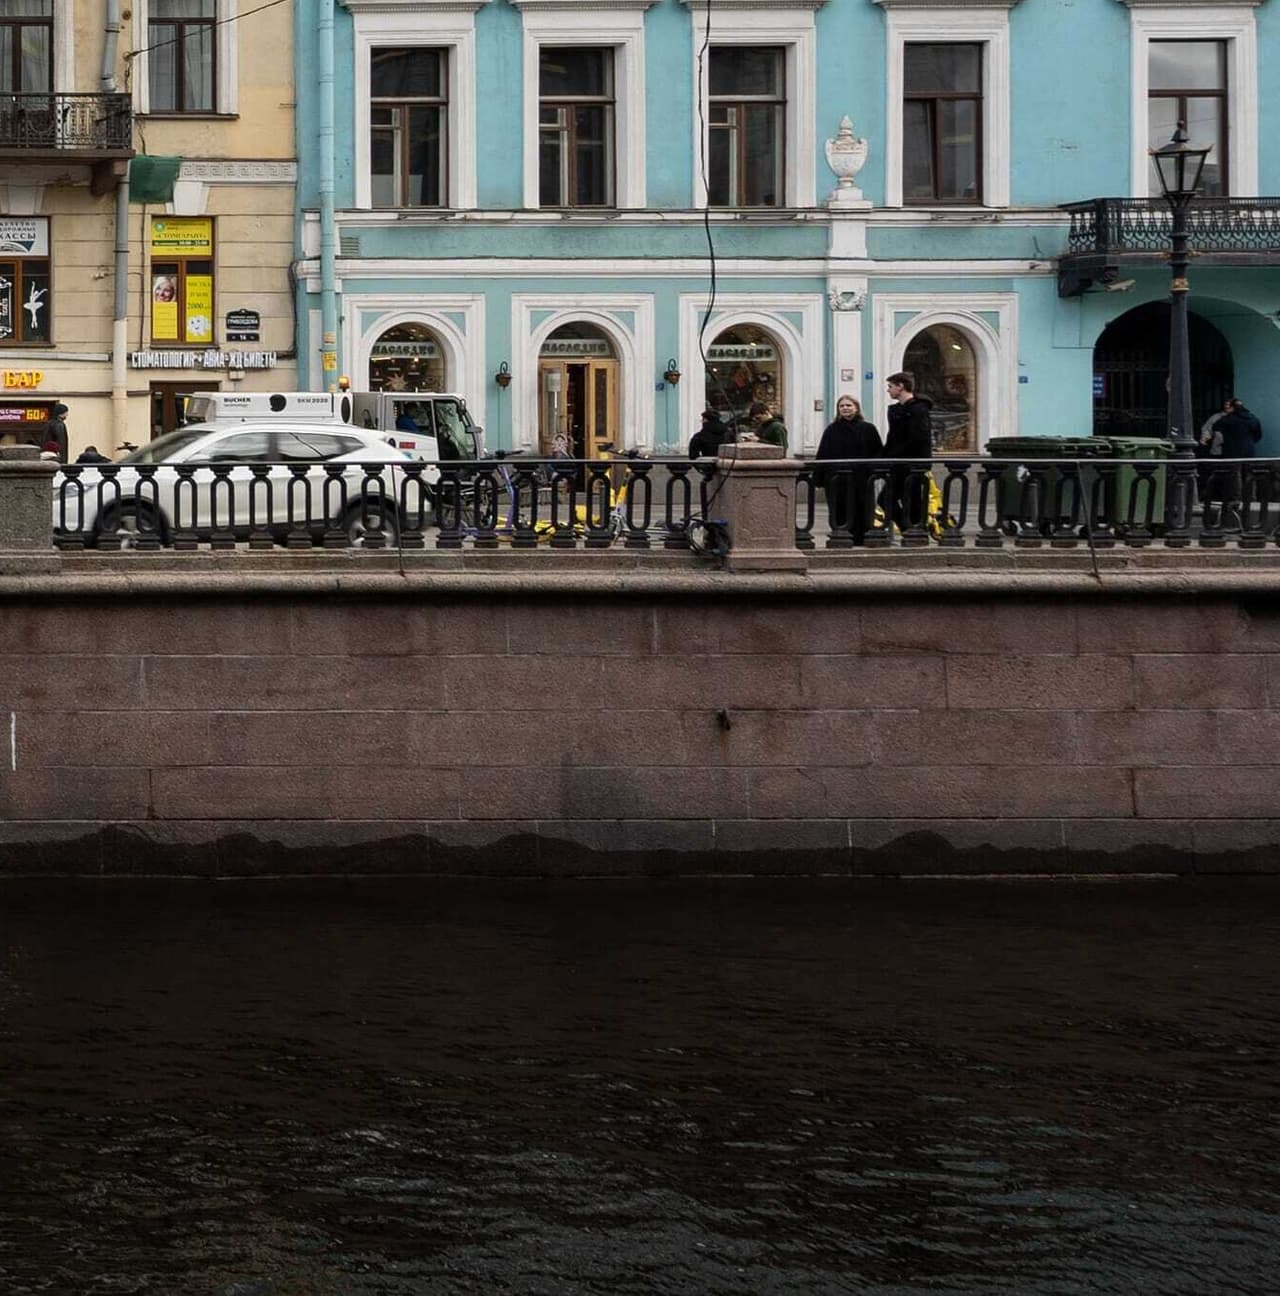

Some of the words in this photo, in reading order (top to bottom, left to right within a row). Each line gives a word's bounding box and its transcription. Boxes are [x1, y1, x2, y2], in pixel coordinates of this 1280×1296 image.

[132, 352, 194, 368] СТОМАТОЛОГИЯ
[244, 352, 277, 368] БИЛЕТЫ
[3, 369, 43, 389] БАР
